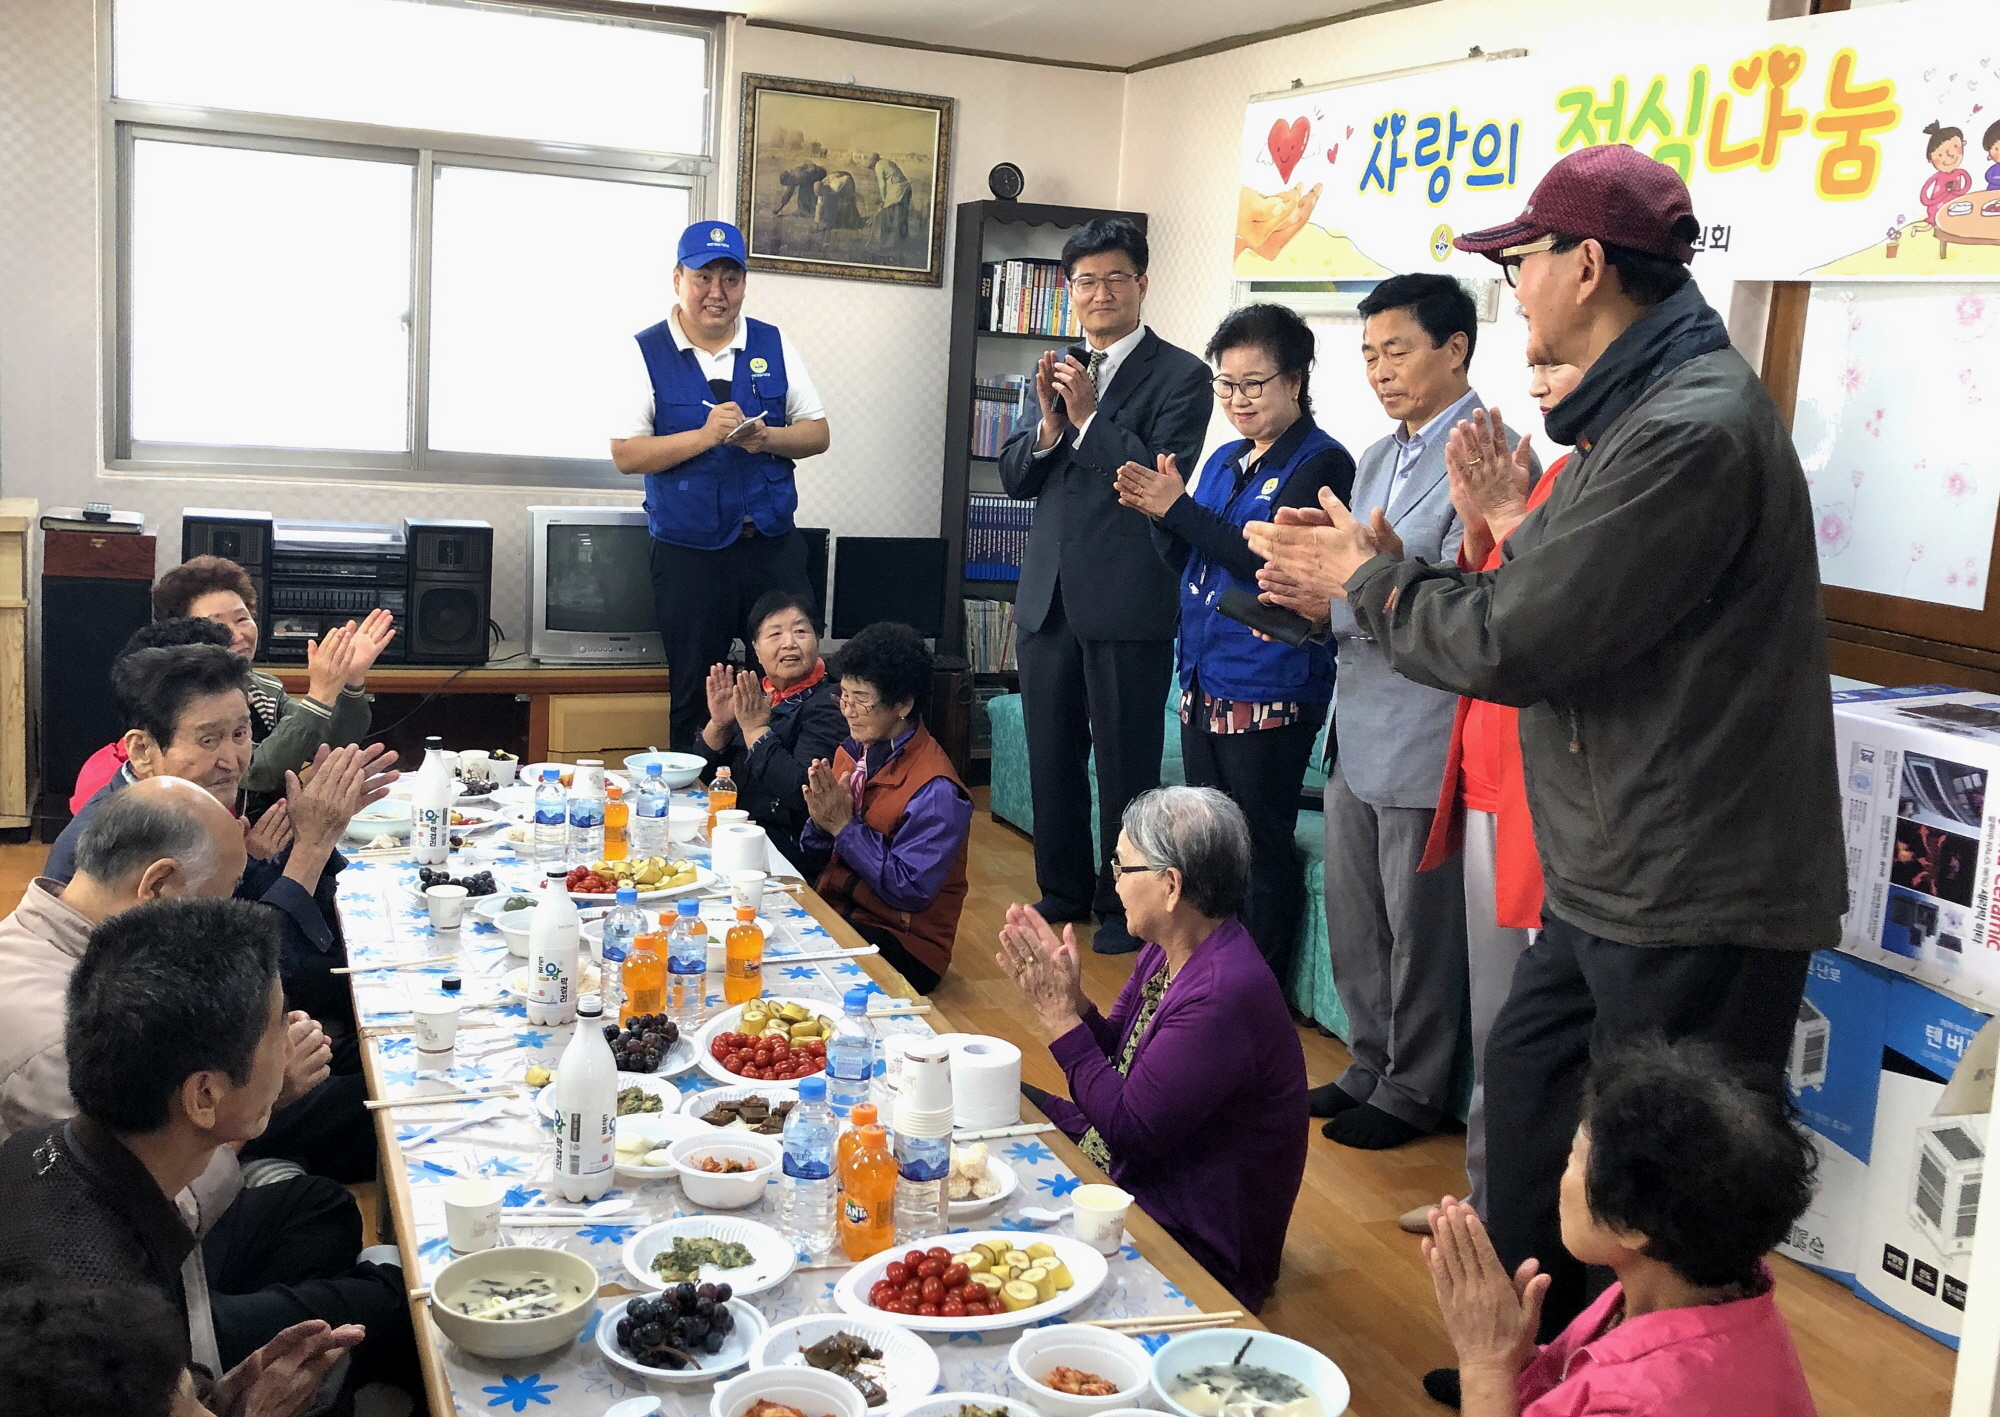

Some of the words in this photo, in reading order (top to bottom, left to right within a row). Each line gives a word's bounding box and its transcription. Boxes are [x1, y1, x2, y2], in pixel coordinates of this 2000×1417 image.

[1357, 111, 1522, 205] 사랑의
[1971, 923, 1985, 944] 히터
[846, 1201, 868, 1218] FANTA
